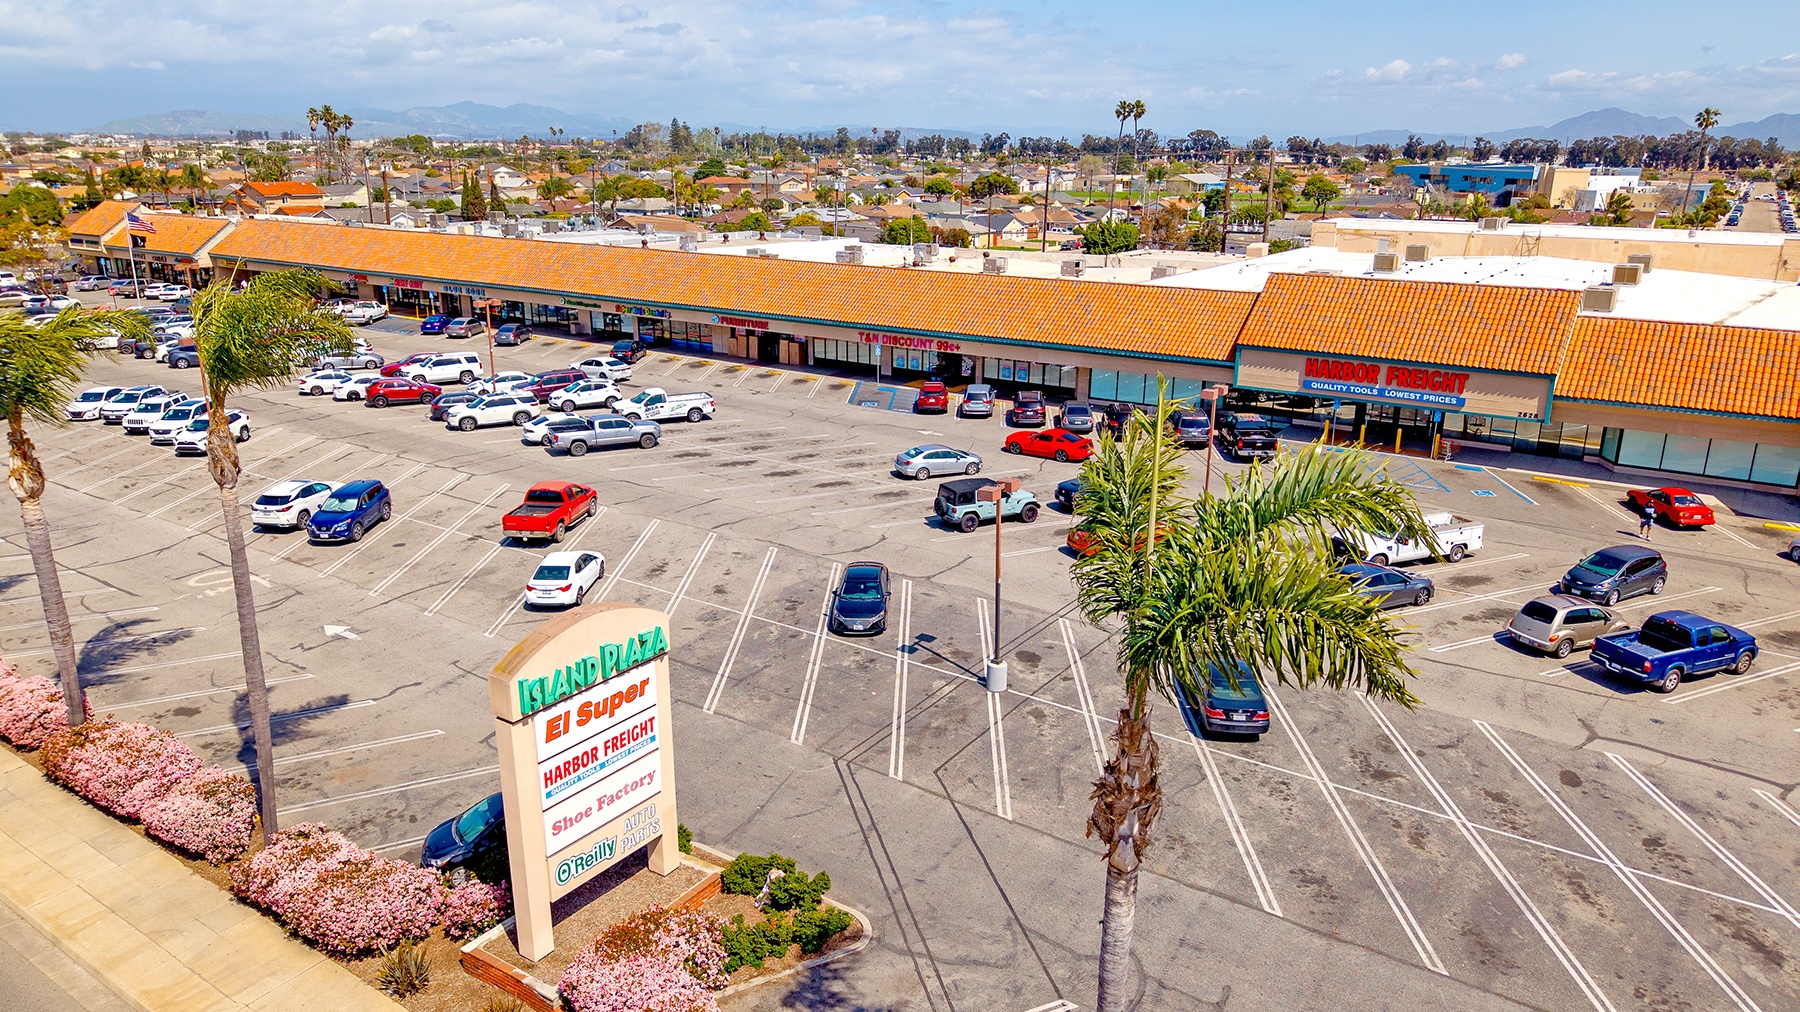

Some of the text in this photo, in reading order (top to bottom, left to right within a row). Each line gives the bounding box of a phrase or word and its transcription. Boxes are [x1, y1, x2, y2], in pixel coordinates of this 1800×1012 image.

[720, 316, 769, 330] FURNITURE
[858, 331, 879, 343] T&N
[881, 334, 934, 350] DISCOUNT
[1305, 358, 1469, 394] HARBOR FREIGHT
[1311, 381, 1457, 405] QUALITY TOOLS LOWEST PRICES
[518, 625, 669, 715] ISLAND PLAZA
[545, 677, 650, 744] El Super
[544, 716, 655, 789] HARBOR FREIGHT
[551, 737, 651, 795] QUALITY TOOLS LOWEST PRICES
[551, 769, 656, 837] Shoe Factory
[623, 803, 657, 835] AUTO
[620, 818, 661, 854] PARTS
[556, 838, 617, 883] O'Reilly
